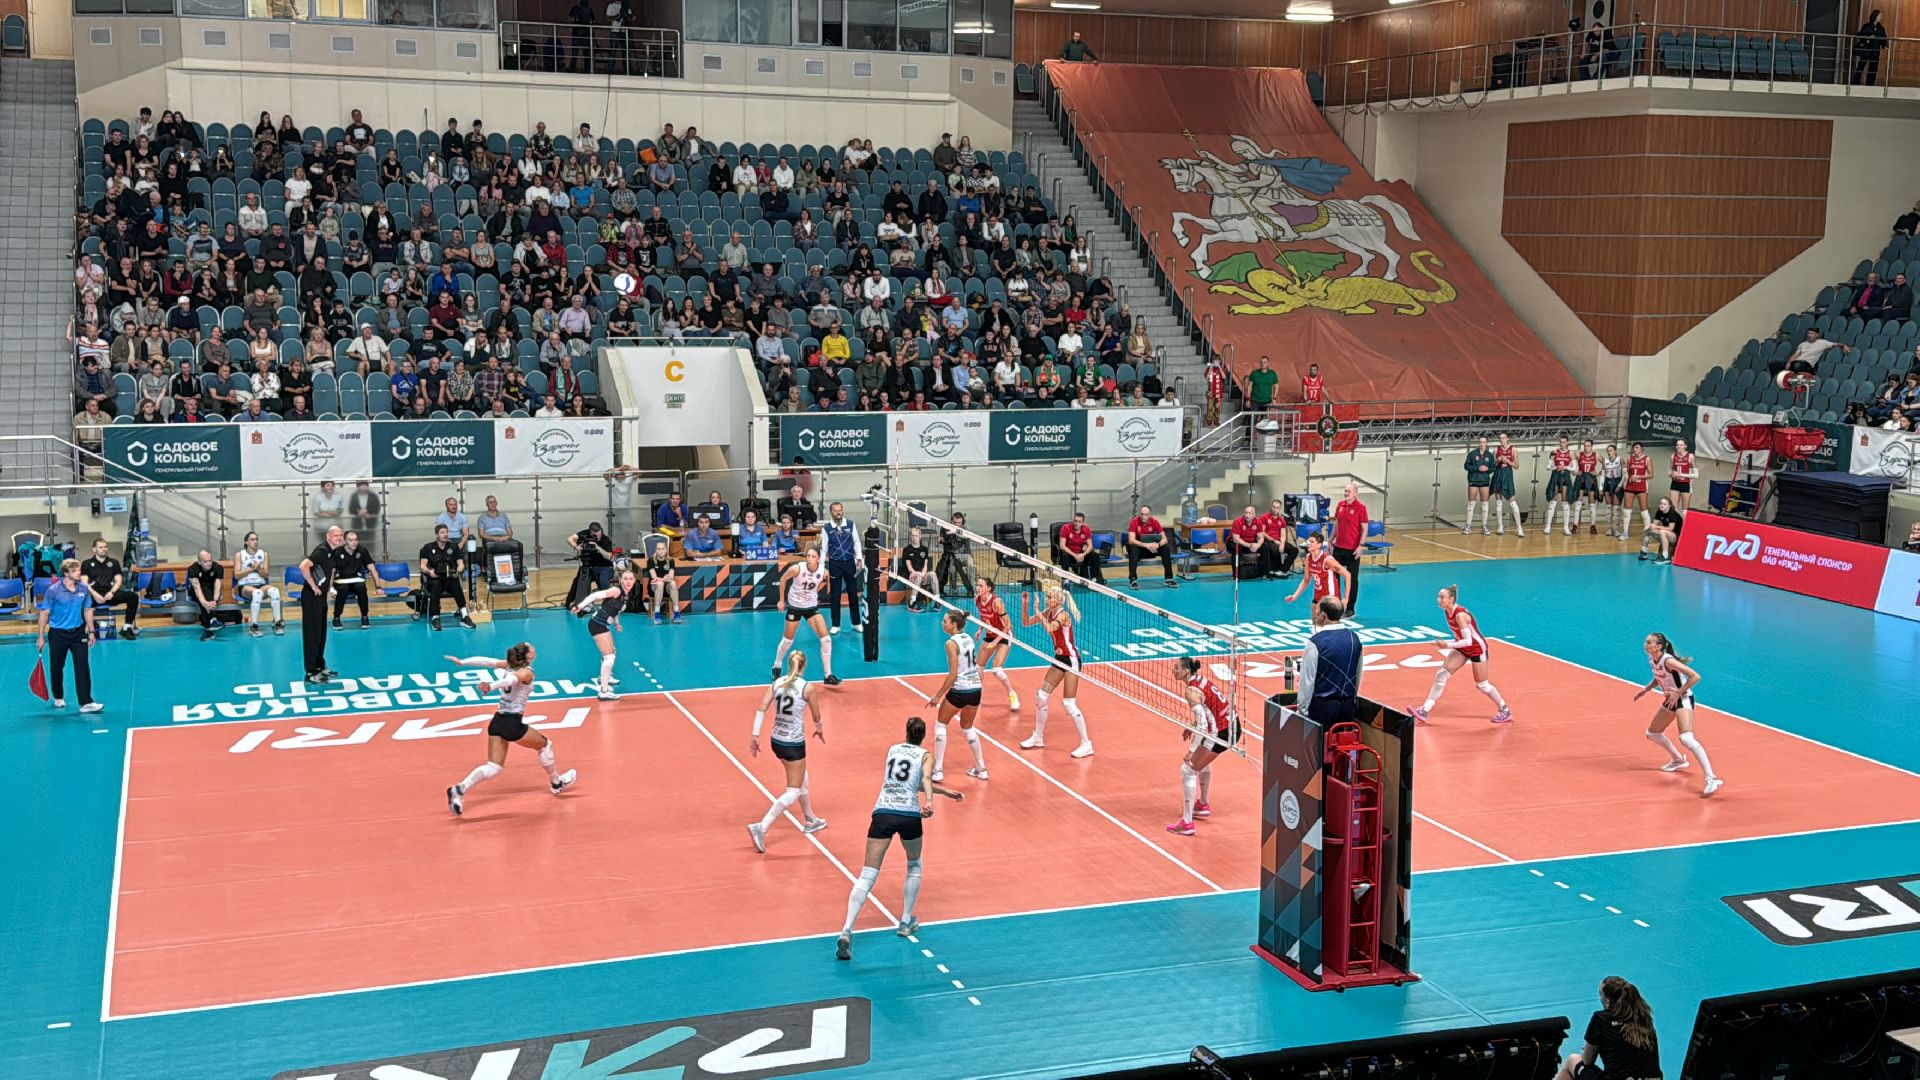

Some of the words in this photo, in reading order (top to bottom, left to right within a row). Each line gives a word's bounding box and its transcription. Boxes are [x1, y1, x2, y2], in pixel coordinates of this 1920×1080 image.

[1653, 413, 1686, 425] САДОВОЕ
[1024, 424, 1072, 434] САДОВОЕ
[1652, 421, 1682, 433] КОЛЬЦО
[818, 429, 870, 439] САДОВОЕ
[1024, 434, 1066, 444] КОЛЬЦО
[152, 440, 219, 453] САДОВОЕ
[415, 435, 475, 447] САДОВОЕ
[819, 439, 865, 450] КОЛЬЦО
[153, 452, 212, 465] КОЛЬЦО
[416, 446, 469, 459] КОЛЬЦО
[746, 550, 757, 560] 24
[768, 549, 778, 559] 24
[1764, 545, 1816, 564] ГЕНЕРАЛЬНЫЙ
[1817, 557, 1853, 573] СПОНСОР
[1761, 555, 1777, 566] ОАО
[1777, 559, 1803, 572] «РЖД»
[801, 581, 816, 591] 19
[1211, 686, 1226, 703] 8
[775, 693, 794, 716] 12
[887, 757, 911, 782] 13
[1743, 880, 1920, 940] RI
